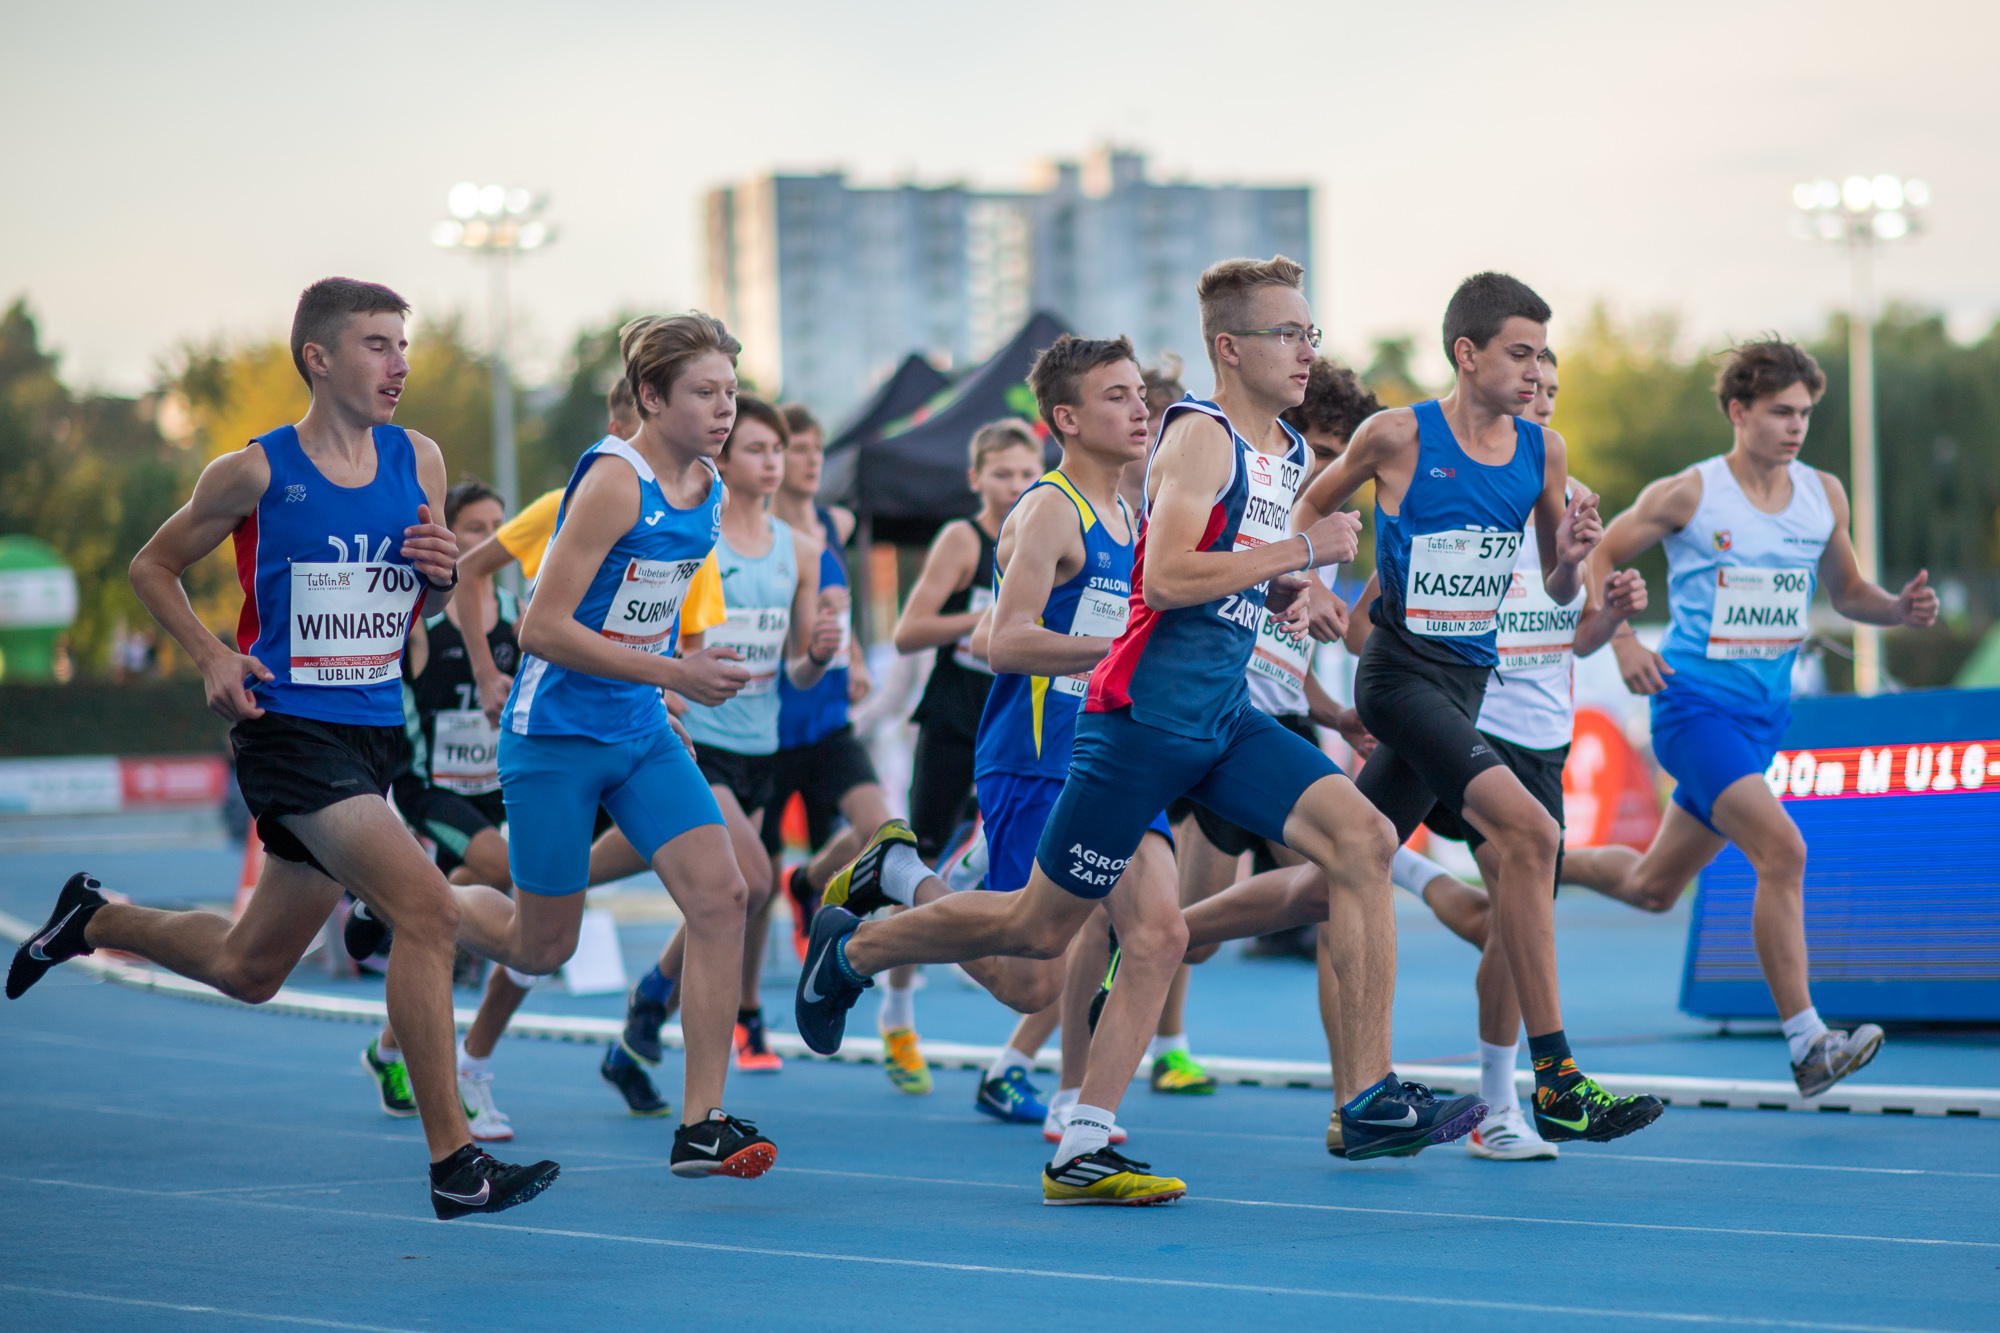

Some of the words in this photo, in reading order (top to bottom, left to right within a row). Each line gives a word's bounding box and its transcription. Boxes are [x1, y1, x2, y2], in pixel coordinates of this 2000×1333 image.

[1281, 464, 1299, 493] 202
[1479, 536, 1516, 559] 579
[366, 567, 414, 593] 700
[671, 562, 700, 584] 798
[1773, 573, 1806, 593] 906
[623, 596, 677, 623] SURMA
[1723, 606, 1798, 627] JANIAK
[758, 613, 785, 631] 816
[1426, 620, 1466, 632] LUBLIN
[1506, 656, 1538, 667] LUBLIN
[1541, 653, 1562, 664] 2022
[1726, 647, 1761, 656] LUBLIN
[317, 668, 364, 680] LUBLIN
[368, 664, 389, 679] 2022
[1253, 657, 1286, 680] LUBLIN
[1069, 861, 1120, 885] ŻARY
